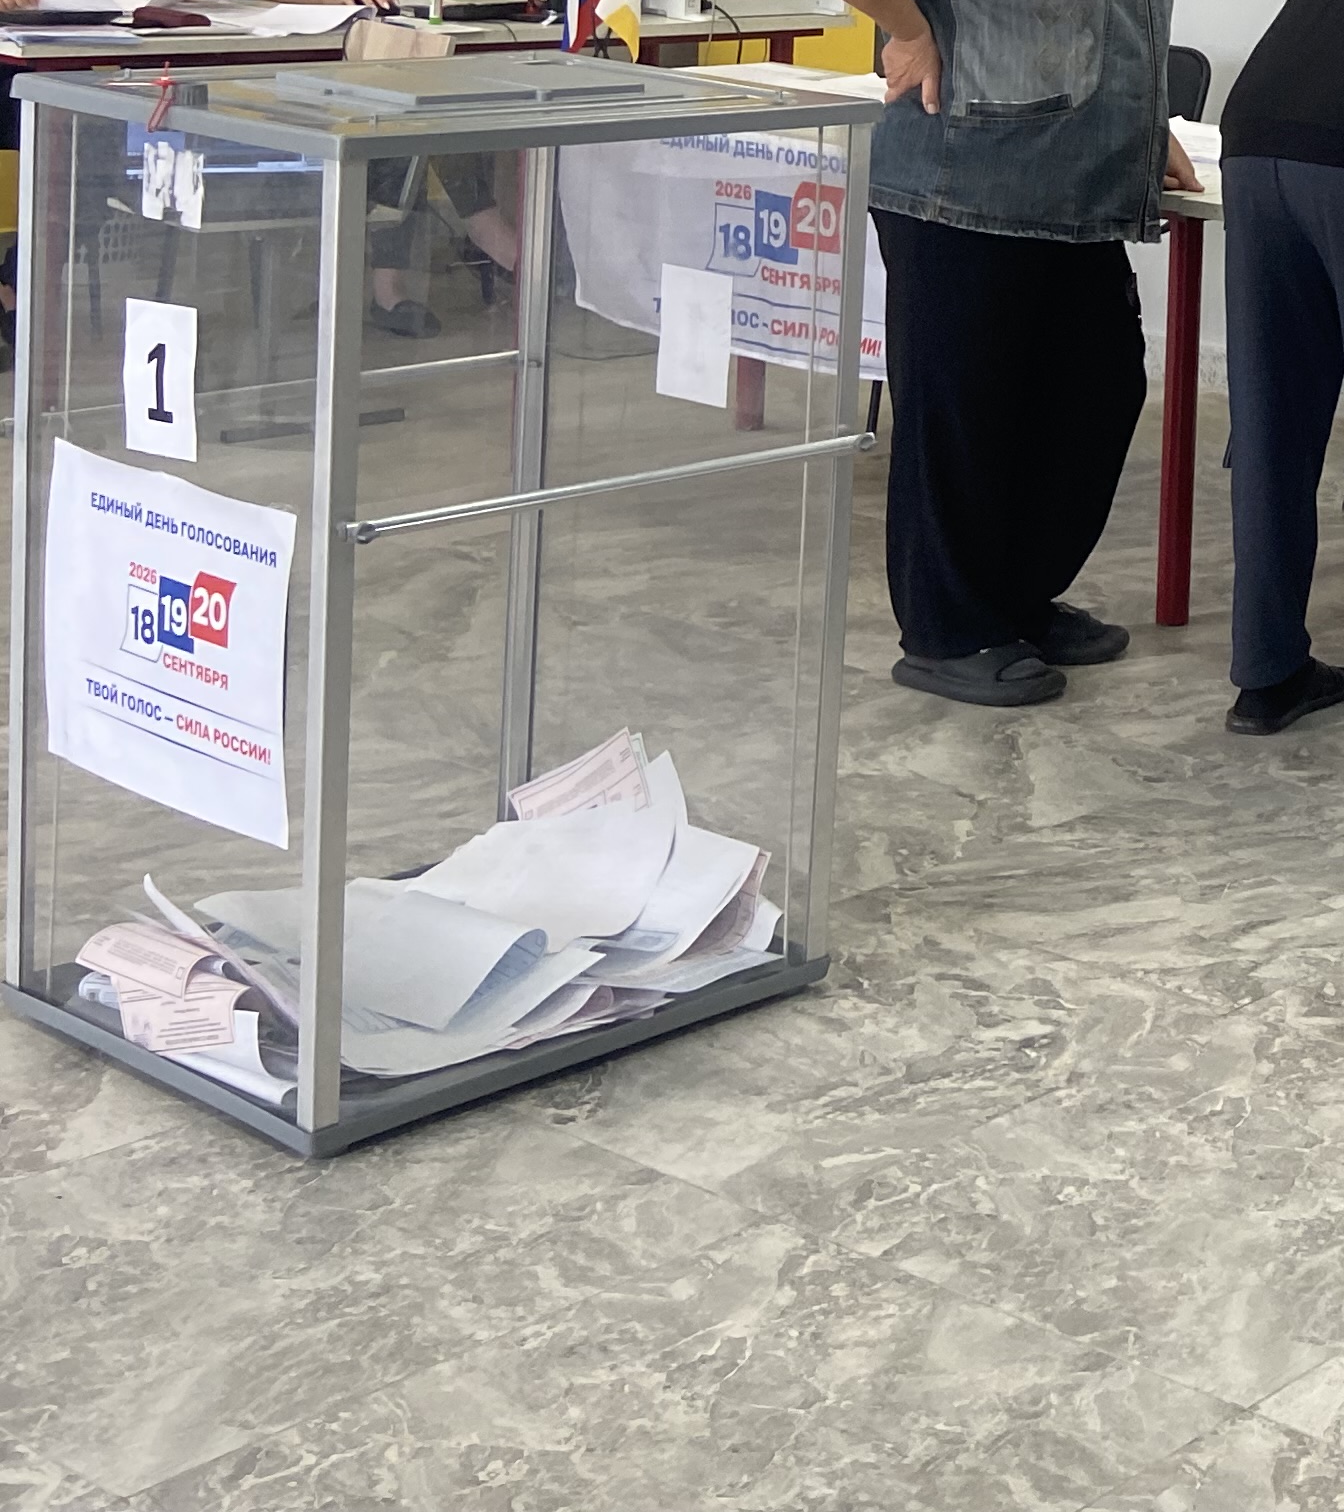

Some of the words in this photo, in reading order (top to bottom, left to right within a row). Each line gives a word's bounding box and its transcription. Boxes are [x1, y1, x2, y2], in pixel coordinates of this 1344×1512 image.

[733, 140, 773, 160] ДЕНЬ
[715, 181, 751, 200] 2026
[719, 223, 752, 261] 18
[759, 209, 787, 248] 19
[796, 198, 837, 237] 20
[147, 343, 174, 424] 1
[91, 492, 142, 523] ЕДИНЫЙ
[145, 509, 178, 534] ДЕНЬ
[181, 521, 277, 568] ГОЛОСОВАНИЯ
[129, 561, 157, 585] 2026
[131, 606, 155, 645] 18
[161, 594, 188, 637] 19
[193, 587, 227, 632] 20
[163, 652, 229, 690] СЕНТЯБРЯ
[86, 678, 118, 705] ТВОЙ
[121, 692, 162, 721] ГОЛОС
[176, 713, 210, 741] СИЛА
[213, 729, 271, 765] РОССИИ!
